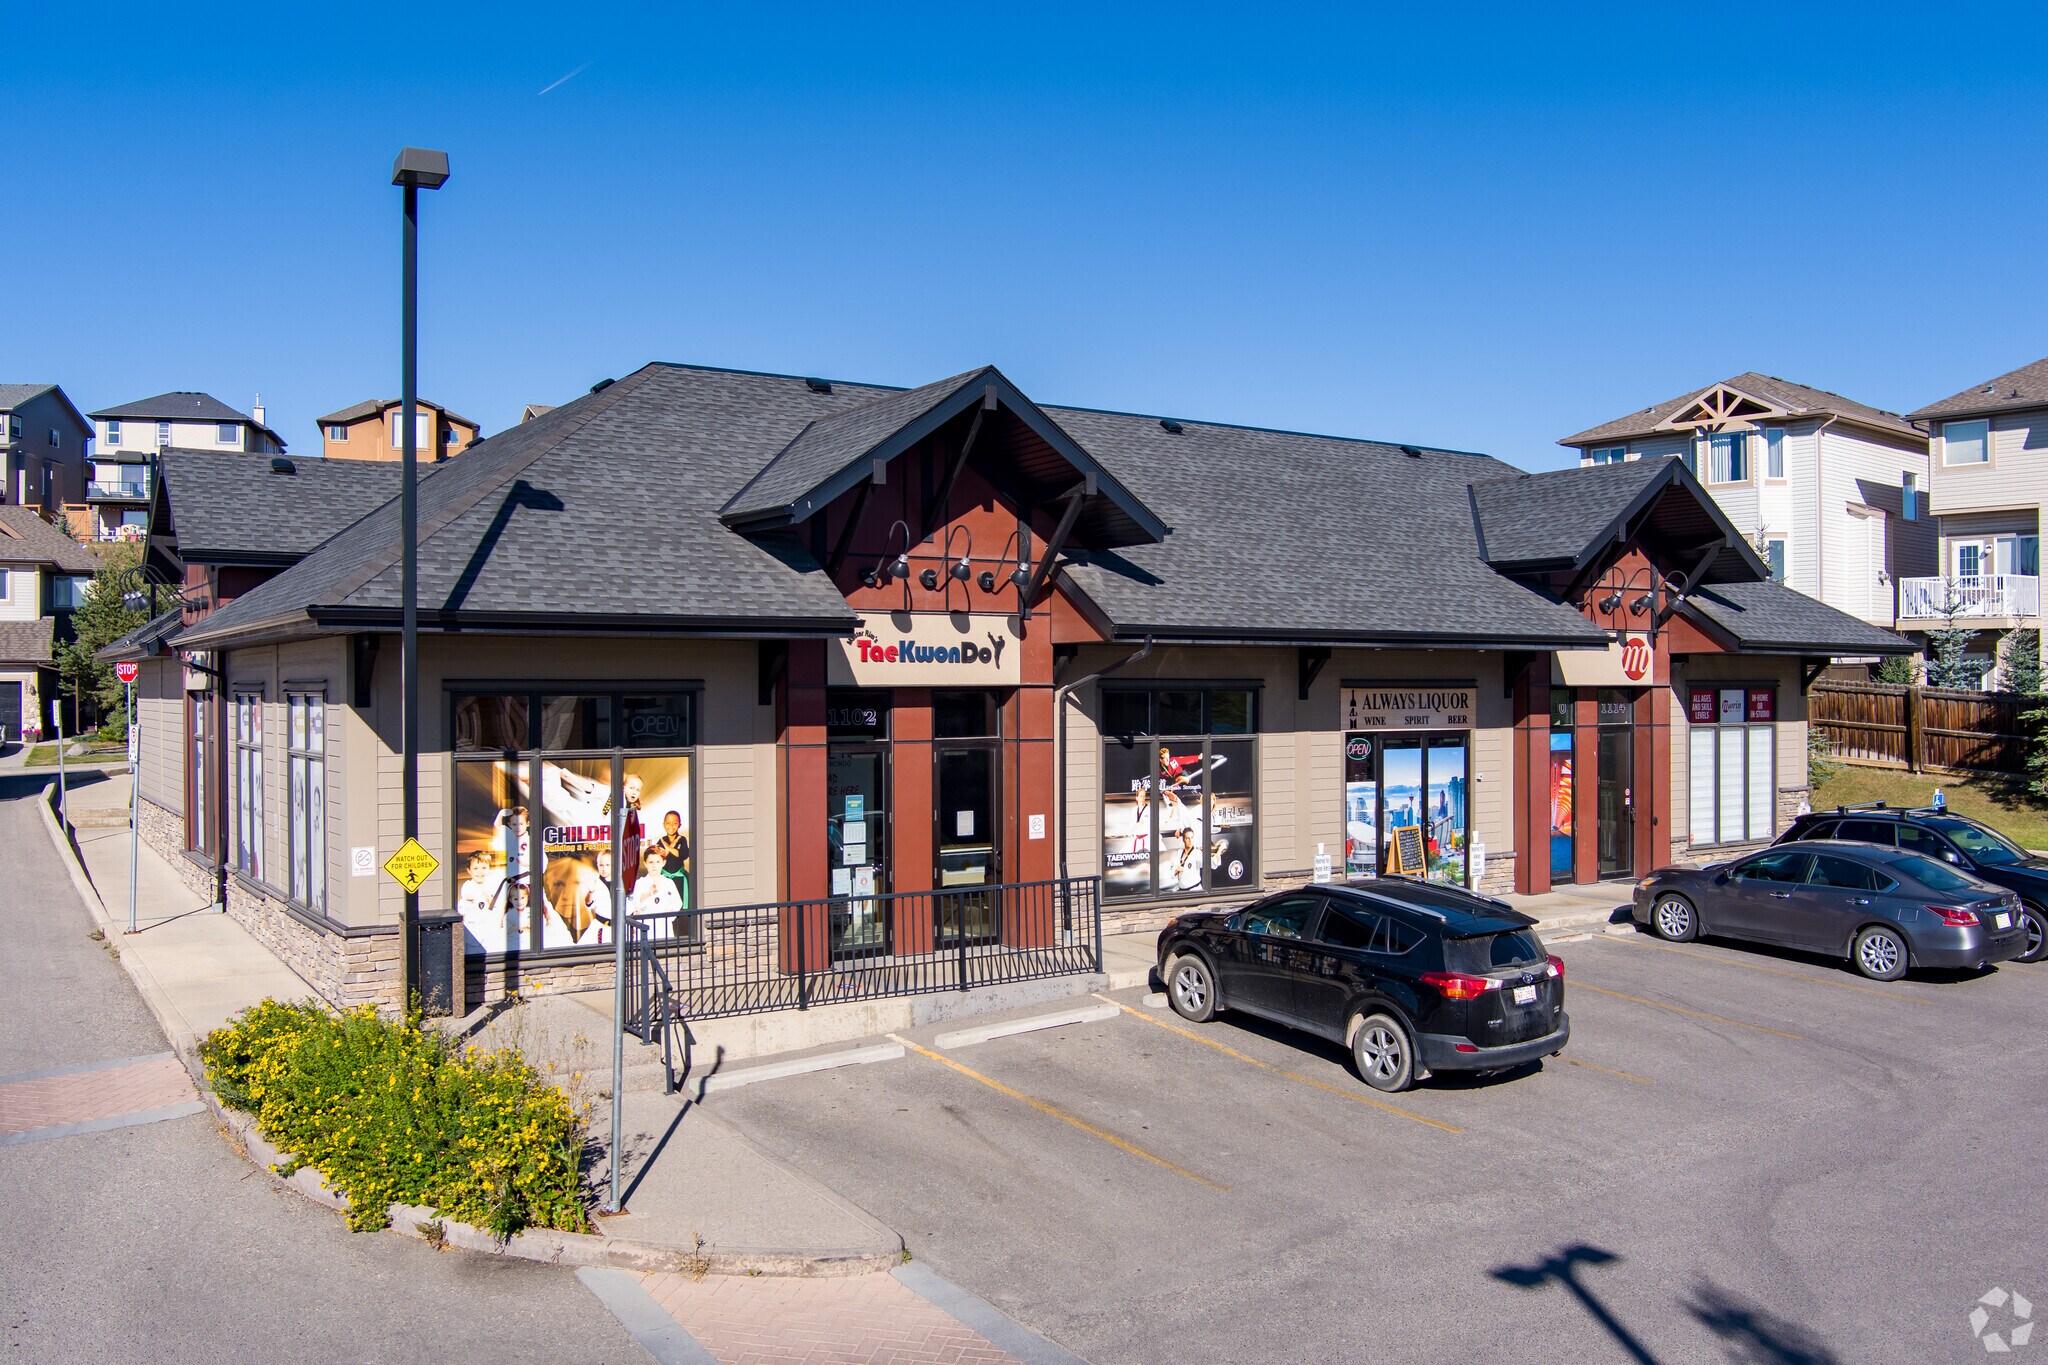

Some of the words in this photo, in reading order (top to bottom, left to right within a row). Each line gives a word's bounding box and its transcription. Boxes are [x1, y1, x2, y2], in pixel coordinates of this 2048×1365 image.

[864, 629, 879, 644] Rim's
[856, 639, 992, 664] TaeKwonDo
[118, 663, 138, 675] STOP
[1362, 692, 1416, 710] ALWAYS
[1418, 692, 1469, 712] LIQUOR
[1701, 694, 1712, 702] AGES
[1751, 694, 1769, 702] IN-HOME
[1601, 703, 1626, 714] 1114
[1692, 703, 1701, 711] AND
[1701, 703, 1713, 711] SKILL
[1756, 702, 1764, 710] OR
[828, 708, 877, 726] 1102
[1694, 711, 1710, 720] LEVELS
[1750, 710, 1770, 718] IN-STUDIO
[631, 715, 680, 733] OPEN
[1364, 716, 1387, 726] WINE
[1404, 715, 1430, 725] SPIRIT
[1447, 715, 1468, 725] BEER
[1347, 743, 1369, 755] OPEN
[544, 844, 576, 853] Building
[583, 842, 612, 851] Positiv
[622, 833, 640, 872] STOP
[1107, 852, 1150, 862] TAEKWONDO
